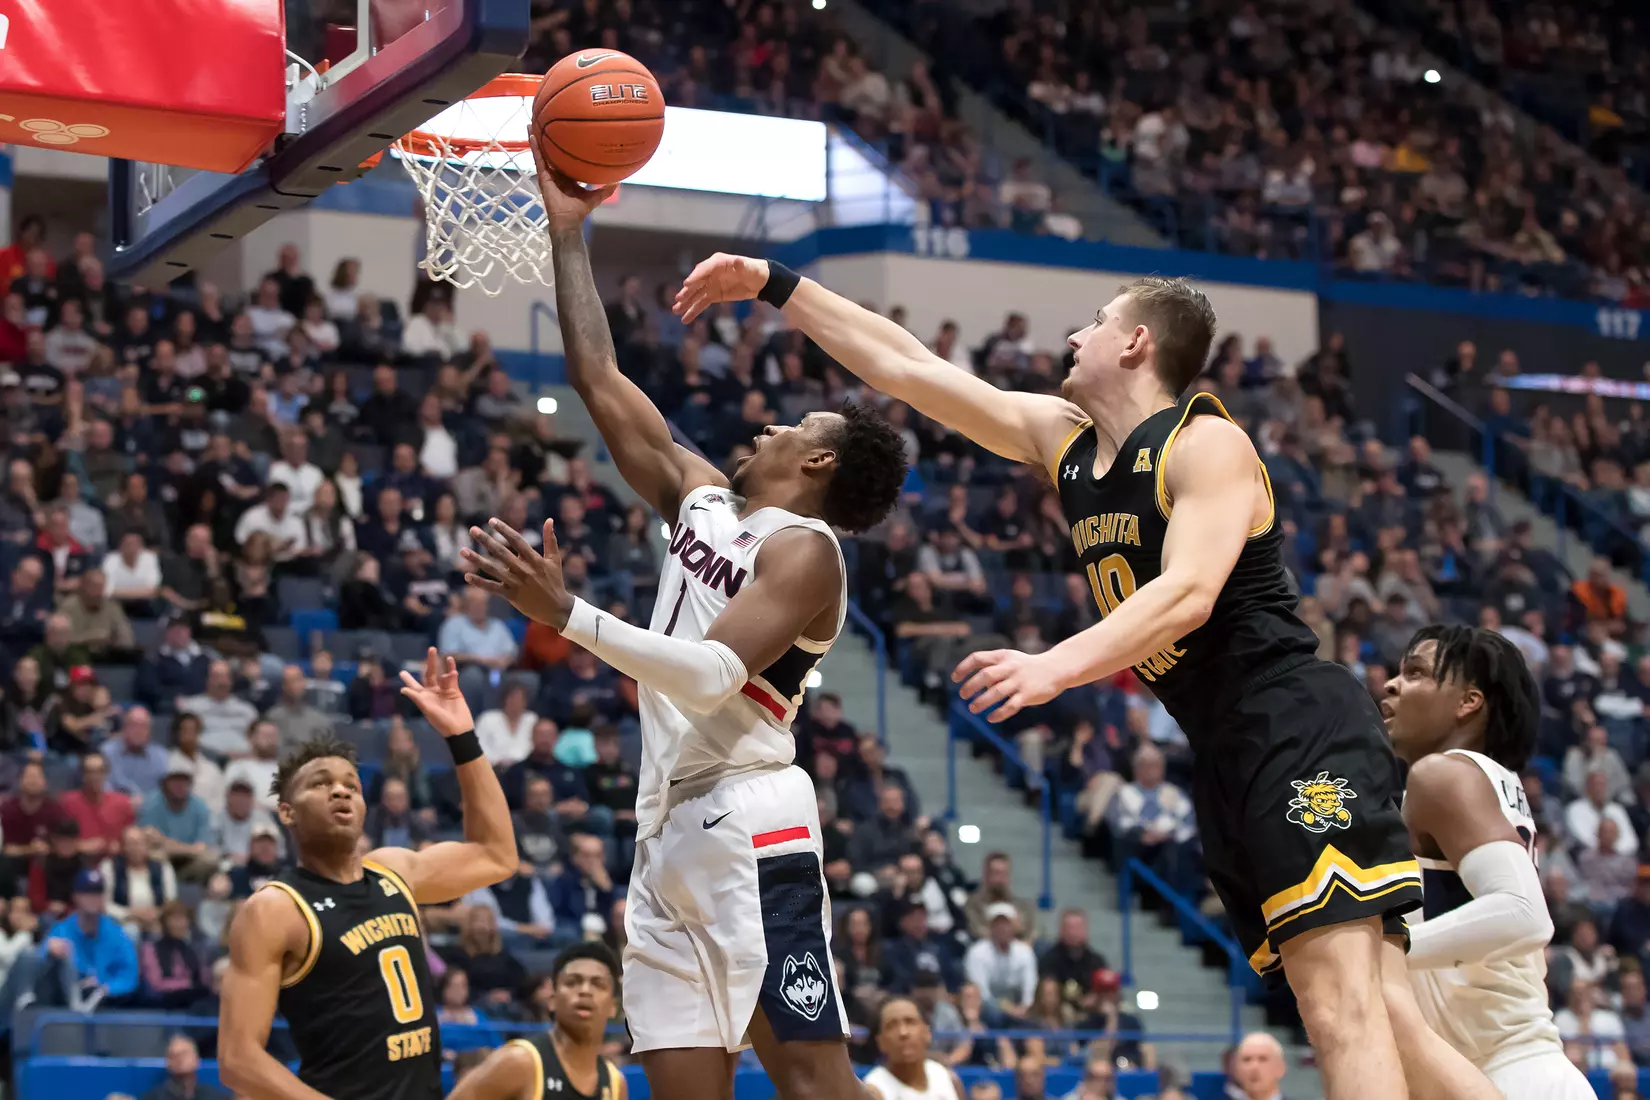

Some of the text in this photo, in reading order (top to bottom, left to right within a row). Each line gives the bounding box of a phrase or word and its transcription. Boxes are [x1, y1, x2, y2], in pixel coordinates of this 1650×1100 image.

[590, 84, 648, 102] ELITE
[1132, 447, 1152, 473] A
[1071, 512, 1142, 558] WICHITA
[668, 522, 748, 599] UCONN
[664, 578, 688, 636] 1
[1086, 553, 1137, 620] 10
[340, 912, 419, 956] WICHITA
[378, 944, 424, 1024] 0
[387, 1026, 431, 1062] STATE
